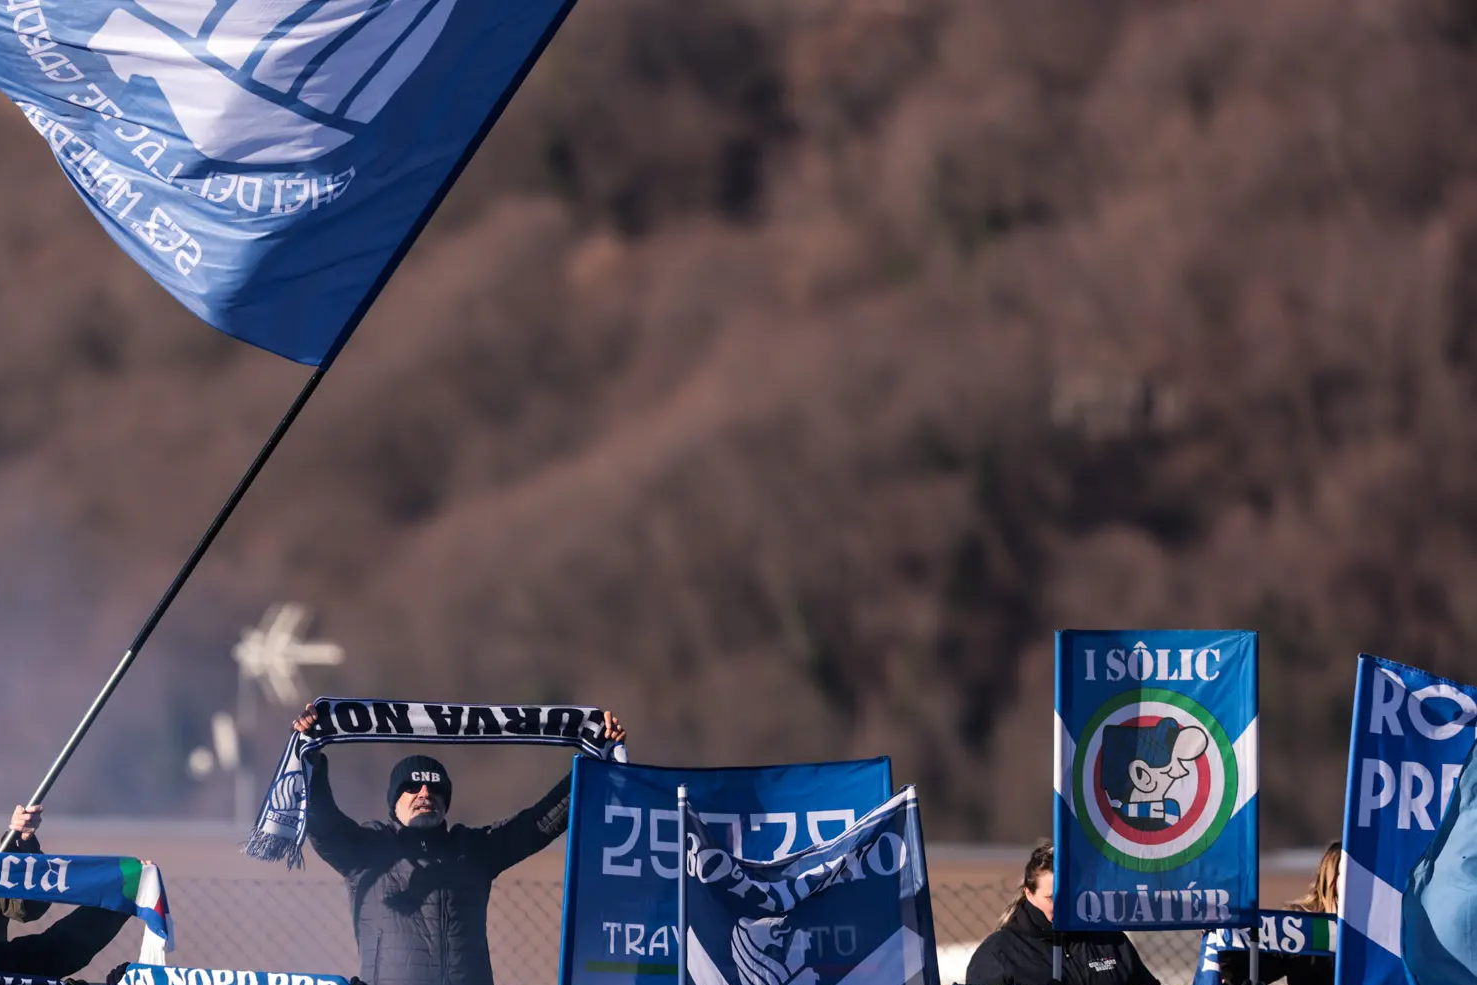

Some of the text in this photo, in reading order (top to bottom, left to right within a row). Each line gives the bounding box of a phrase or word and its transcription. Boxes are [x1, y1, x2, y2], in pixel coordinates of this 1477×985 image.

[1084, 640, 1221, 681] I SÔLIC
[411, 771, 441, 782] CNB
